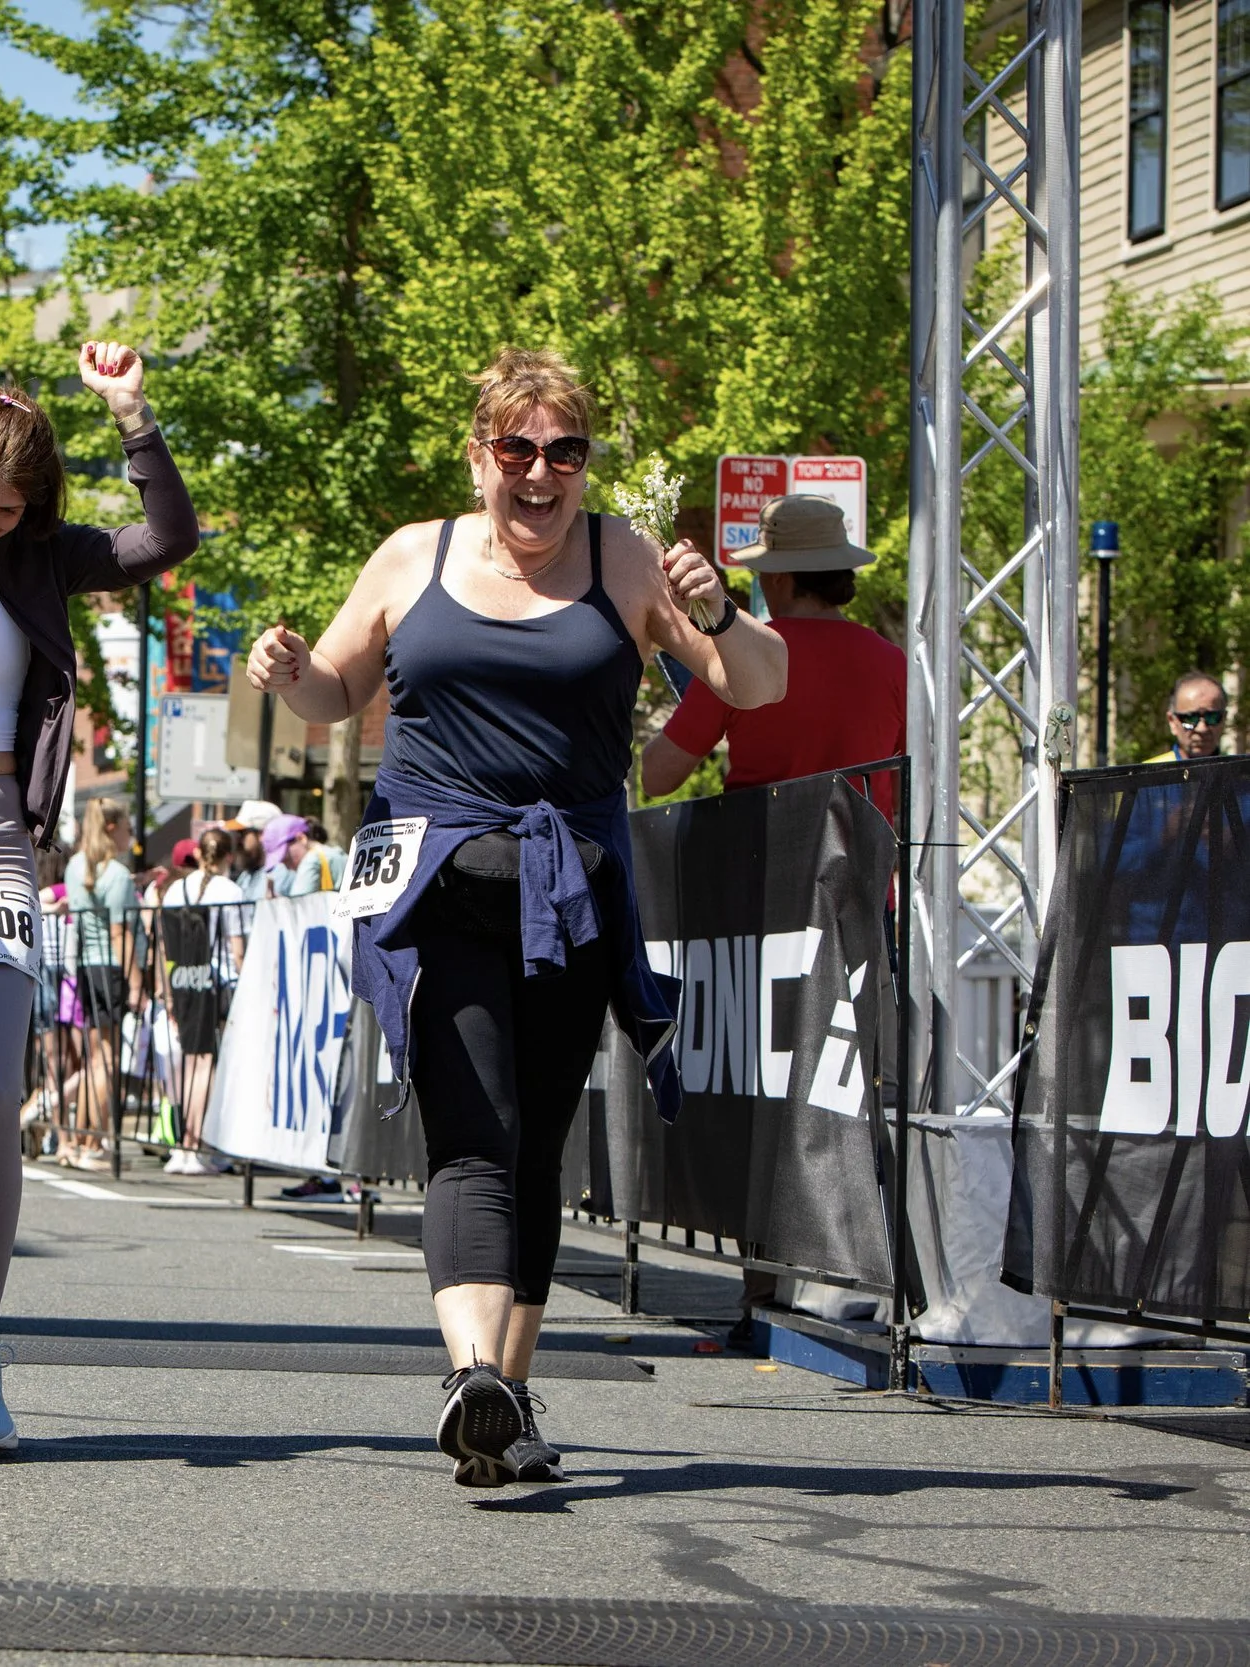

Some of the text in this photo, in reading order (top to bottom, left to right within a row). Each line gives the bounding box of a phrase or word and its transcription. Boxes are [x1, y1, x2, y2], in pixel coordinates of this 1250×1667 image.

[730, 461, 779, 475] TOW ZONE
[798, 463, 859, 478] TOW ZONE
[743, 477, 764, 492] NO
[722, 493, 785, 510] PARKI
[350, 843, 402, 891] 253
